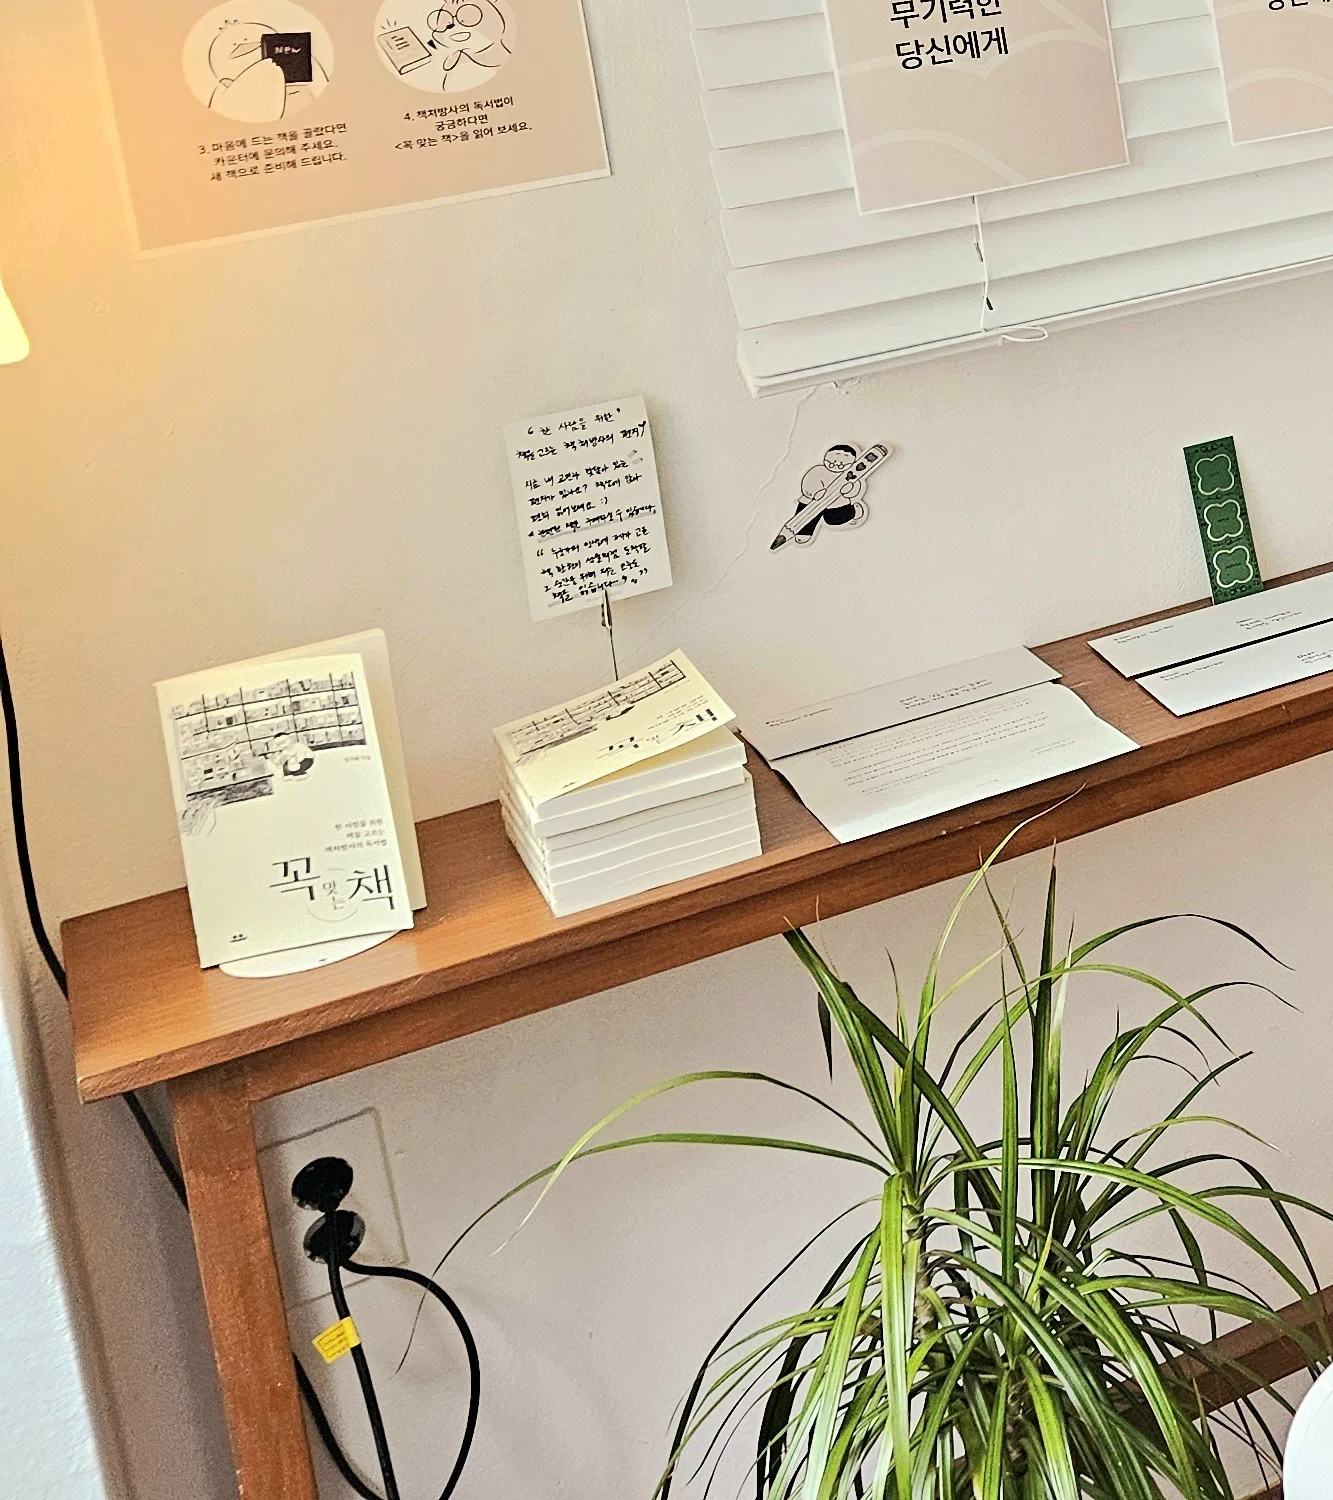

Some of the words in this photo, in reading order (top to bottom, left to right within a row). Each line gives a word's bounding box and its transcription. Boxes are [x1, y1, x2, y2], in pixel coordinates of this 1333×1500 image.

[895, 22, 1009, 70] 당신에게
[269, 856, 321, 901] 꼭
[346, 864, 395, 911] 책
